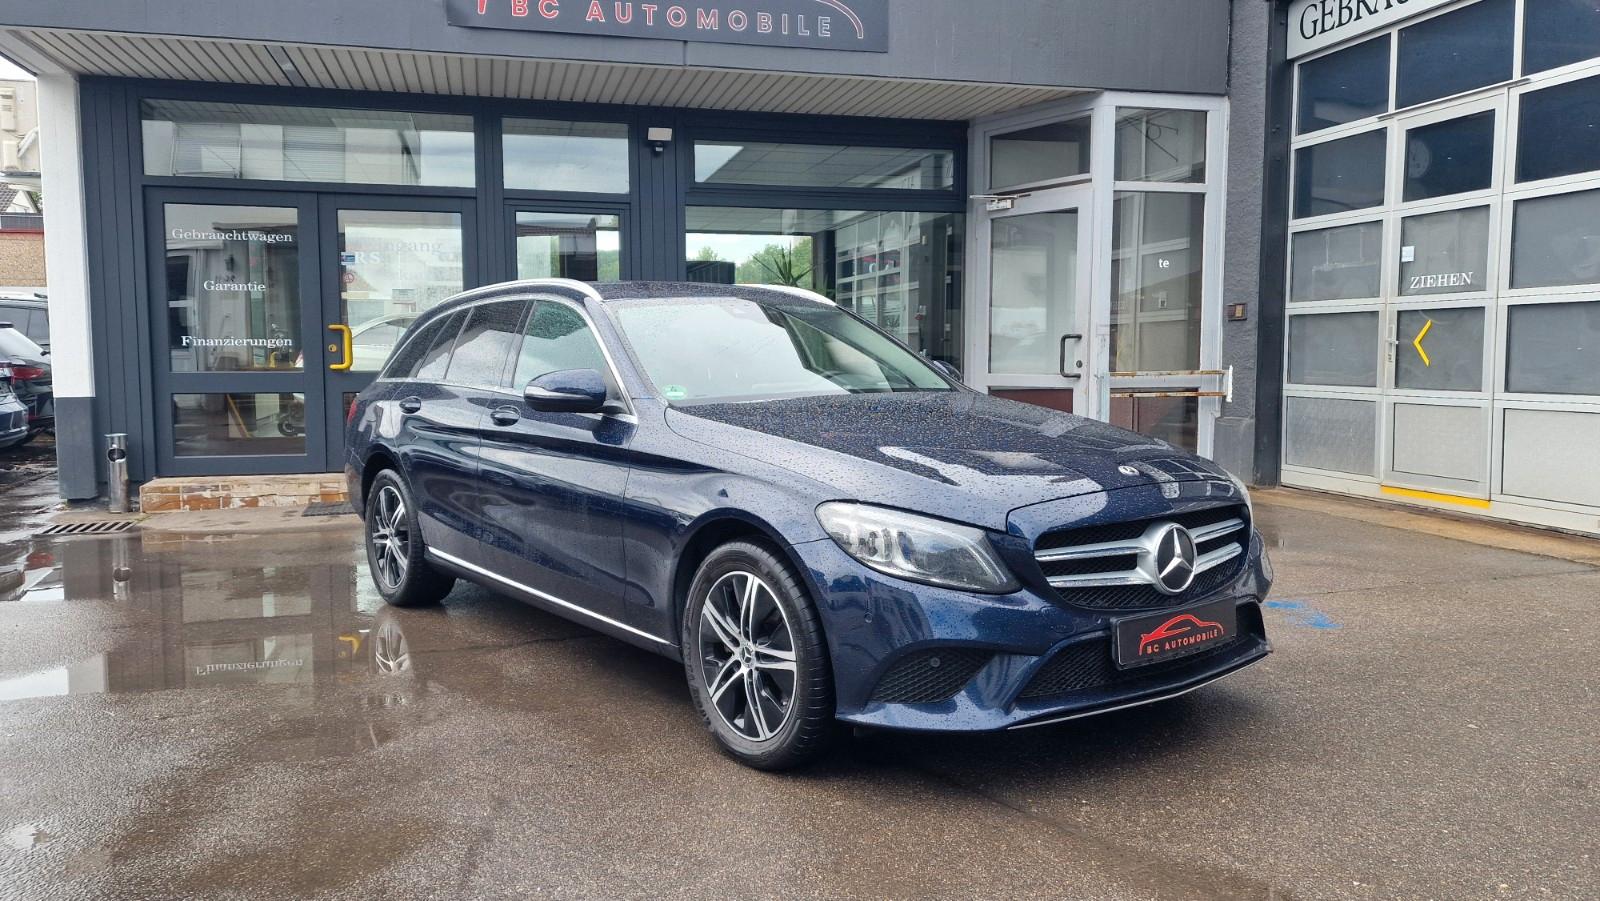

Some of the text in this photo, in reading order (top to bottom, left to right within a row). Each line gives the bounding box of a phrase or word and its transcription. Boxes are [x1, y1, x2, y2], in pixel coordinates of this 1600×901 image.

[511, 0, 831, 38] BC AUTOMOBILE
[171, 228, 293, 243] Gebrauchtwagen
[203, 279, 266, 292] Garantie
[1410, 271, 1474, 289] ZIEHEN
[180, 335, 293, 348] Finanzierungen
[1146, 629, 1218, 654] BC AUTOMOBILE
